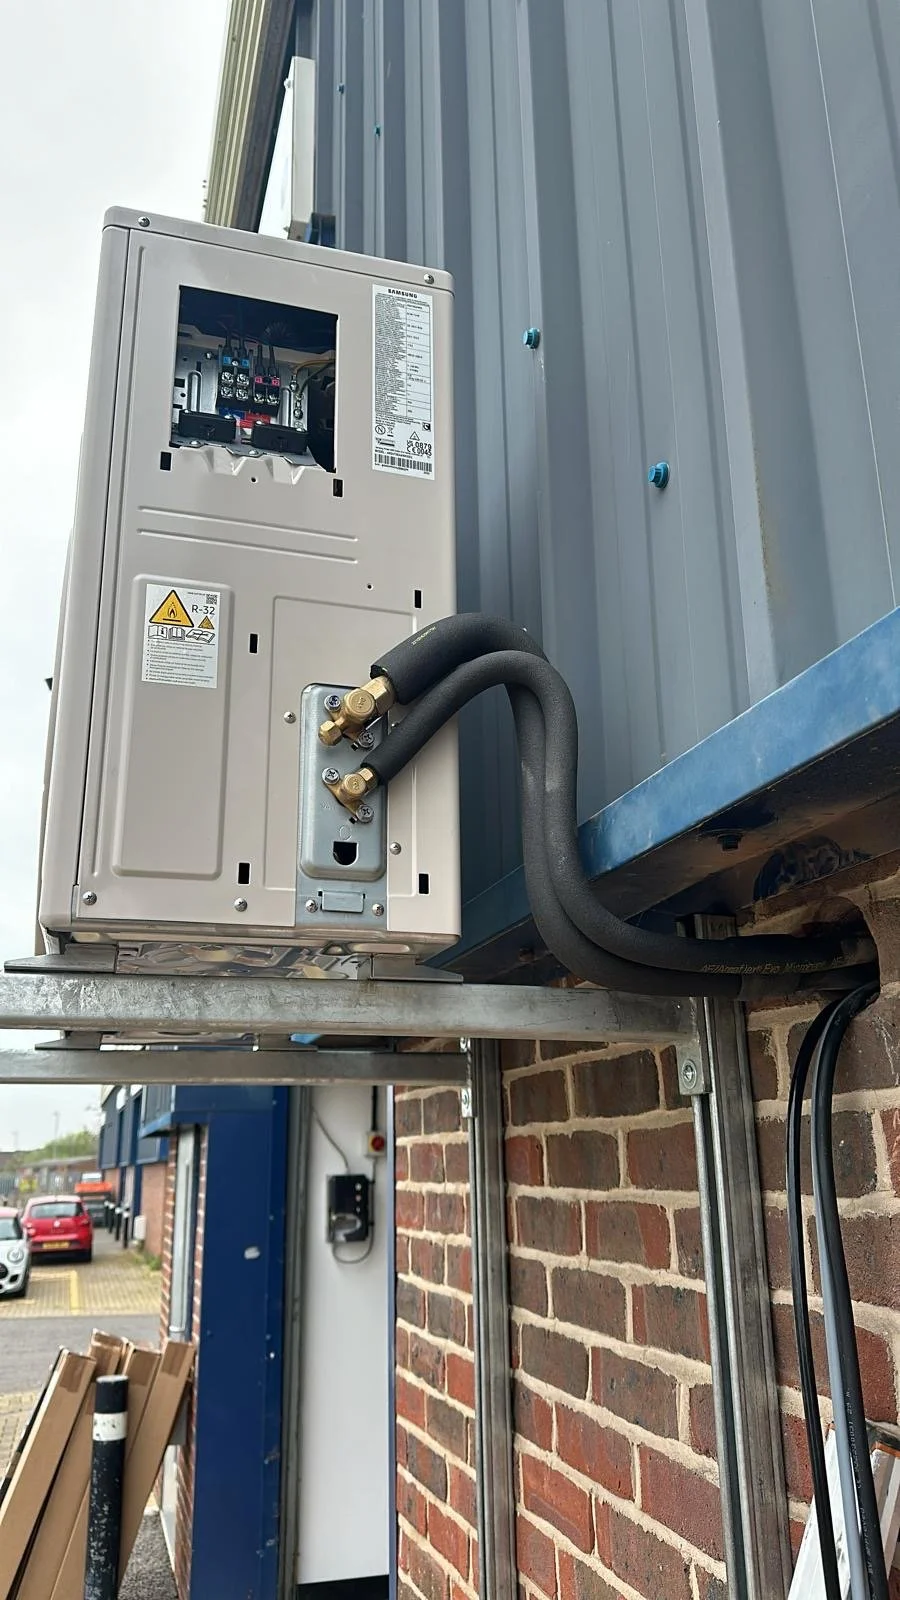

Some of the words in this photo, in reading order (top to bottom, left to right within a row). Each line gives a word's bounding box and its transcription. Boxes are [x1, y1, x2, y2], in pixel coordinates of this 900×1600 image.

[387, 288, 418, 299] SAMSUNG
[415, 441, 432, 450] 0879
[191, 604, 216, 616] R-32
